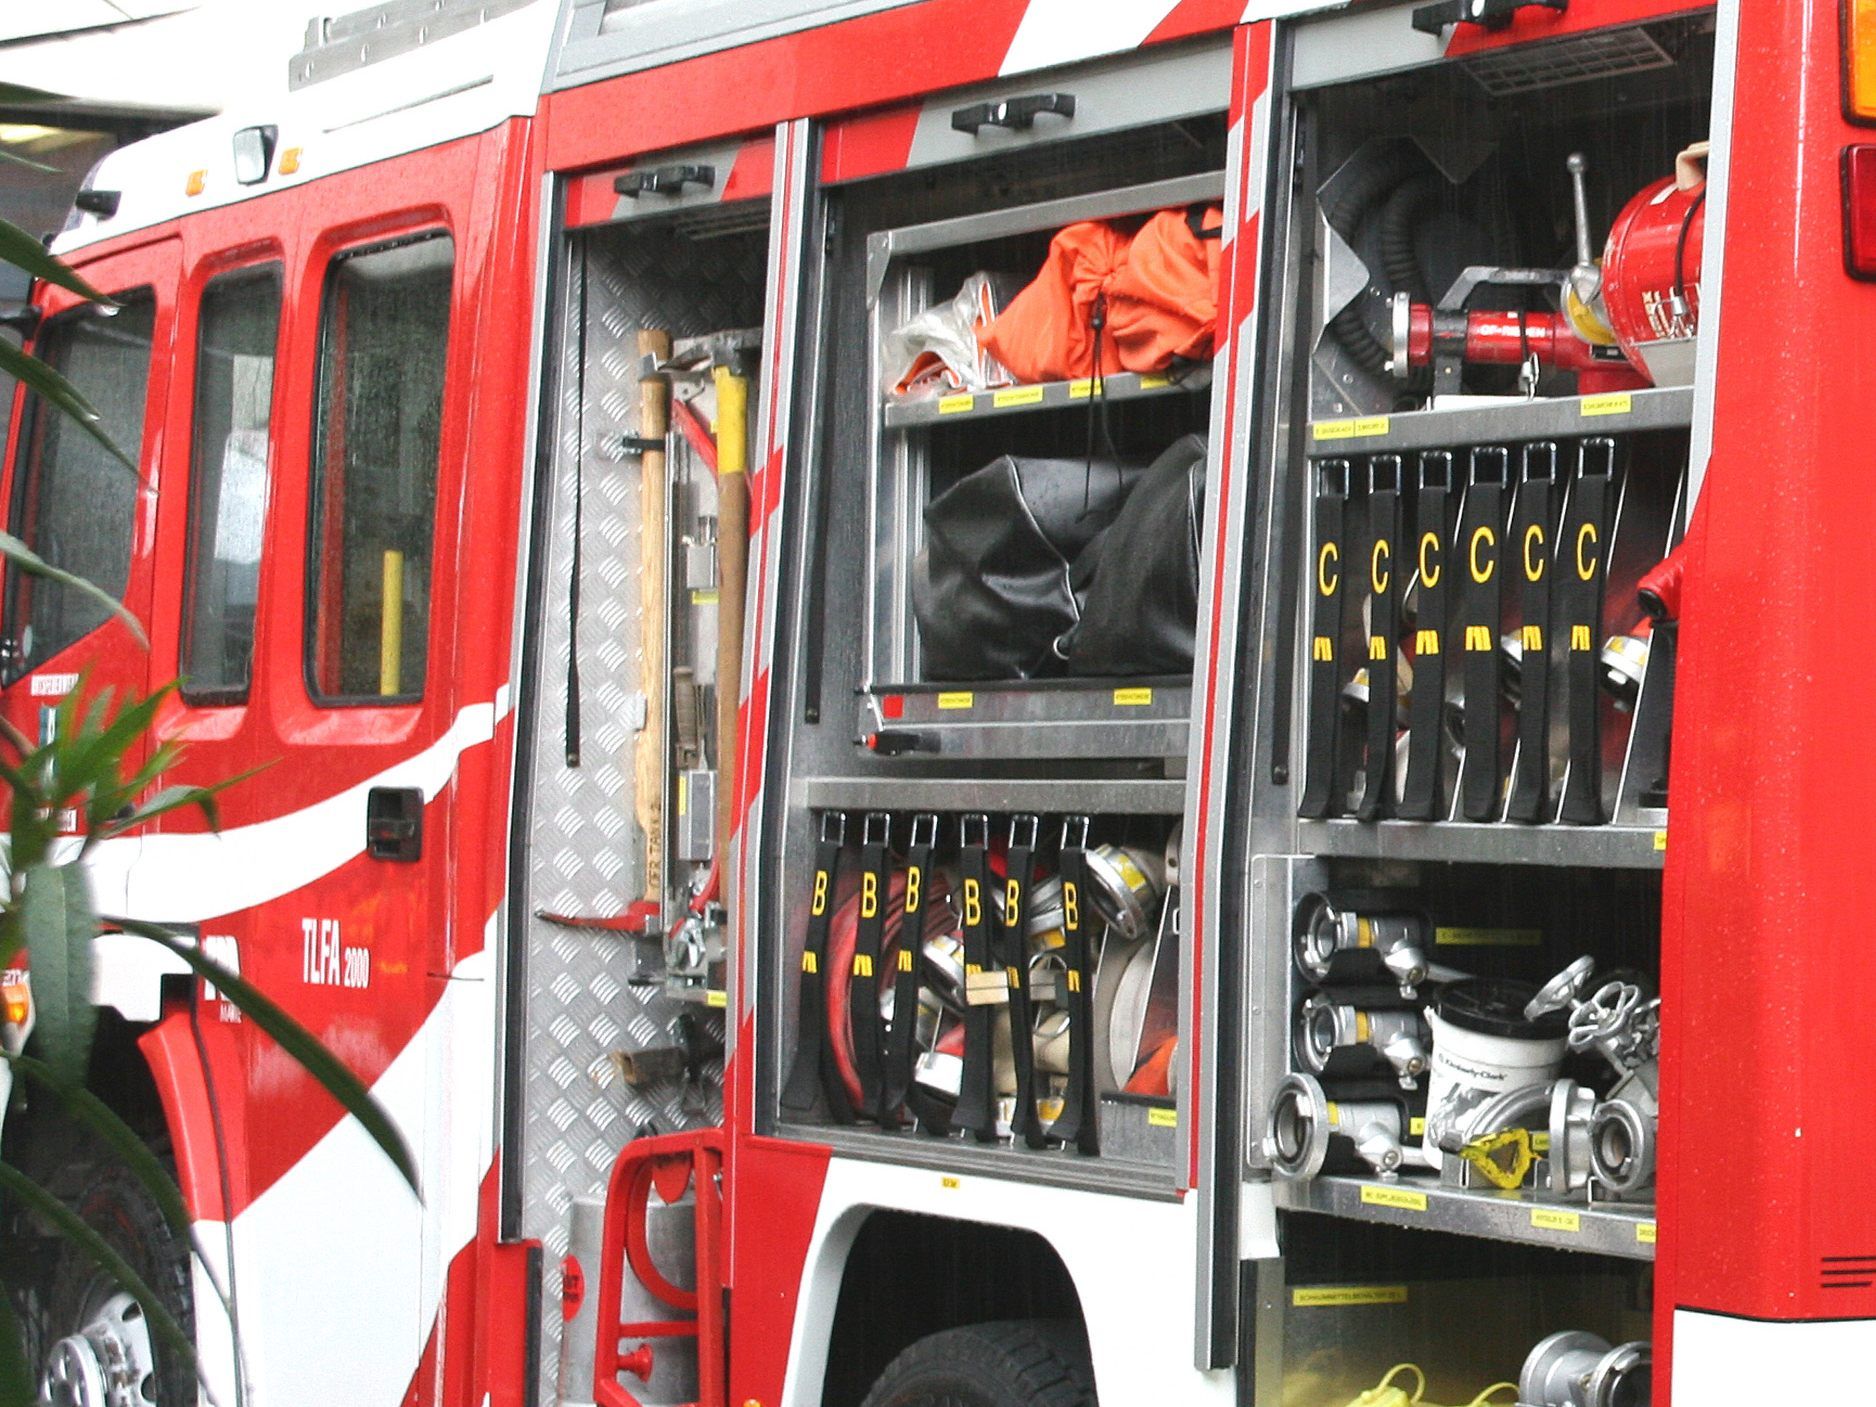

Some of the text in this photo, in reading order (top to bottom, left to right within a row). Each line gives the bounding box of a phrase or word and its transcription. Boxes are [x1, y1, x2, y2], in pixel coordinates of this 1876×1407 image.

[1319, 541, 1338, 597] C
[1371, 538, 1390, 595] C
[1419, 531, 1440, 589] C
[1469, 525, 1495, 584] C
[1523, 524, 1544, 582] C
[1576, 522, 1597, 581] C
[811, 870, 828, 917] B
[860, 871, 878, 919] B
[904, 865, 921, 914] B
[964, 878, 982, 927] B
[1005, 878, 1020, 928] B
[1063, 881, 1079, 931] B
[302, 917, 342, 986] TLFA
[344, 945, 371, 989] 2000
